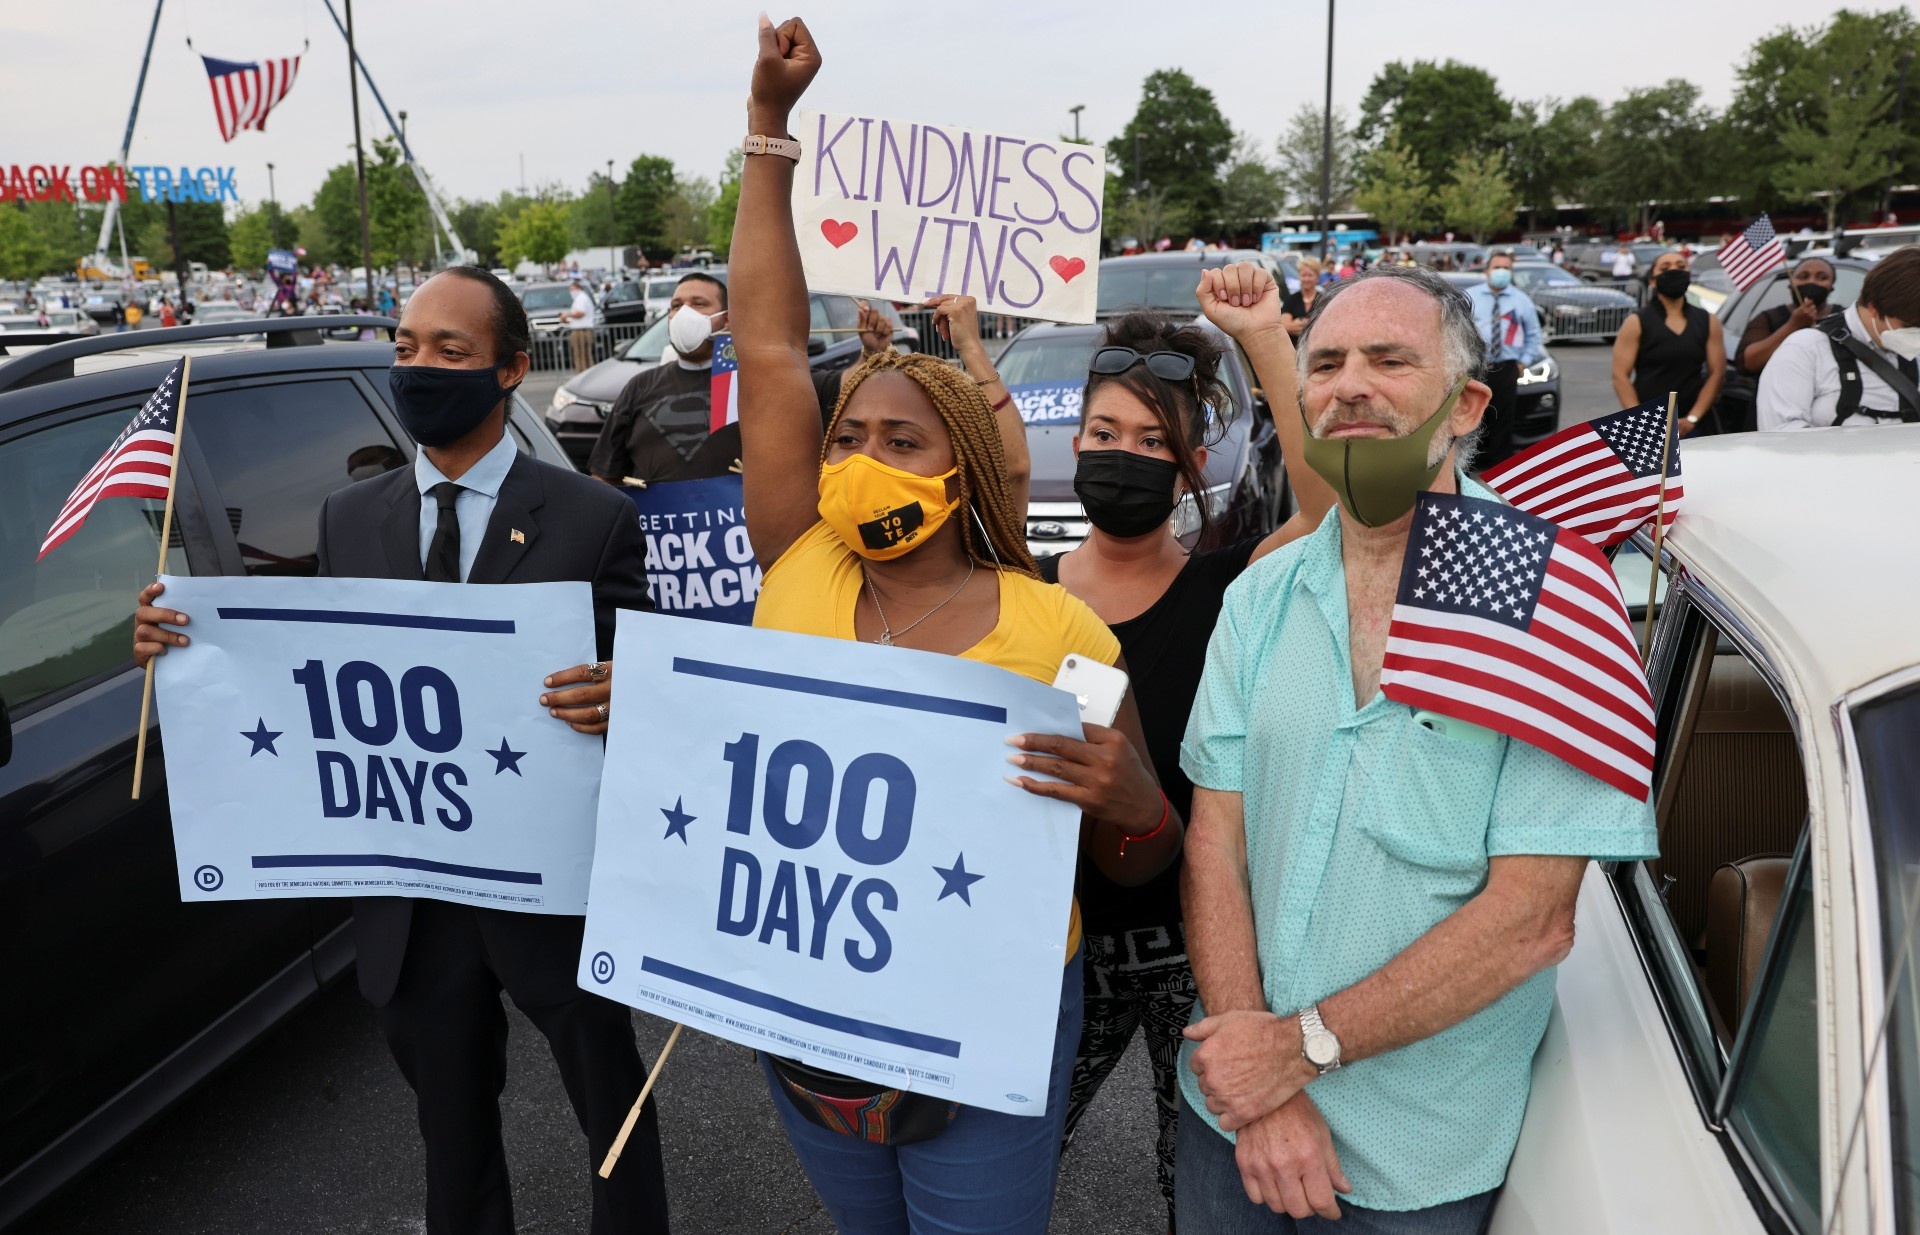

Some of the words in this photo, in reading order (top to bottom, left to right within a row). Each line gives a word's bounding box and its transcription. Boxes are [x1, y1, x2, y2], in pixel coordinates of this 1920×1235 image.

[0, 165, 77, 203] ACK
[81, 166, 127, 203] ON
[132, 166, 238, 203] TRACK
[814, 113, 1100, 234] KINDNESS
[871, 209, 1044, 309] WINS
[1013, 394, 1058, 410] ACK
[1020, 406, 1081, 423] RACK
[644, 531, 716, 571] ACK
[724, 525, 755, 564] O
[292, 659, 463, 754] 100
[316, 750, 473, 833] DAYS
[723, 732, 917, 866] 100
[716, 846, 899, 974] DAYS
